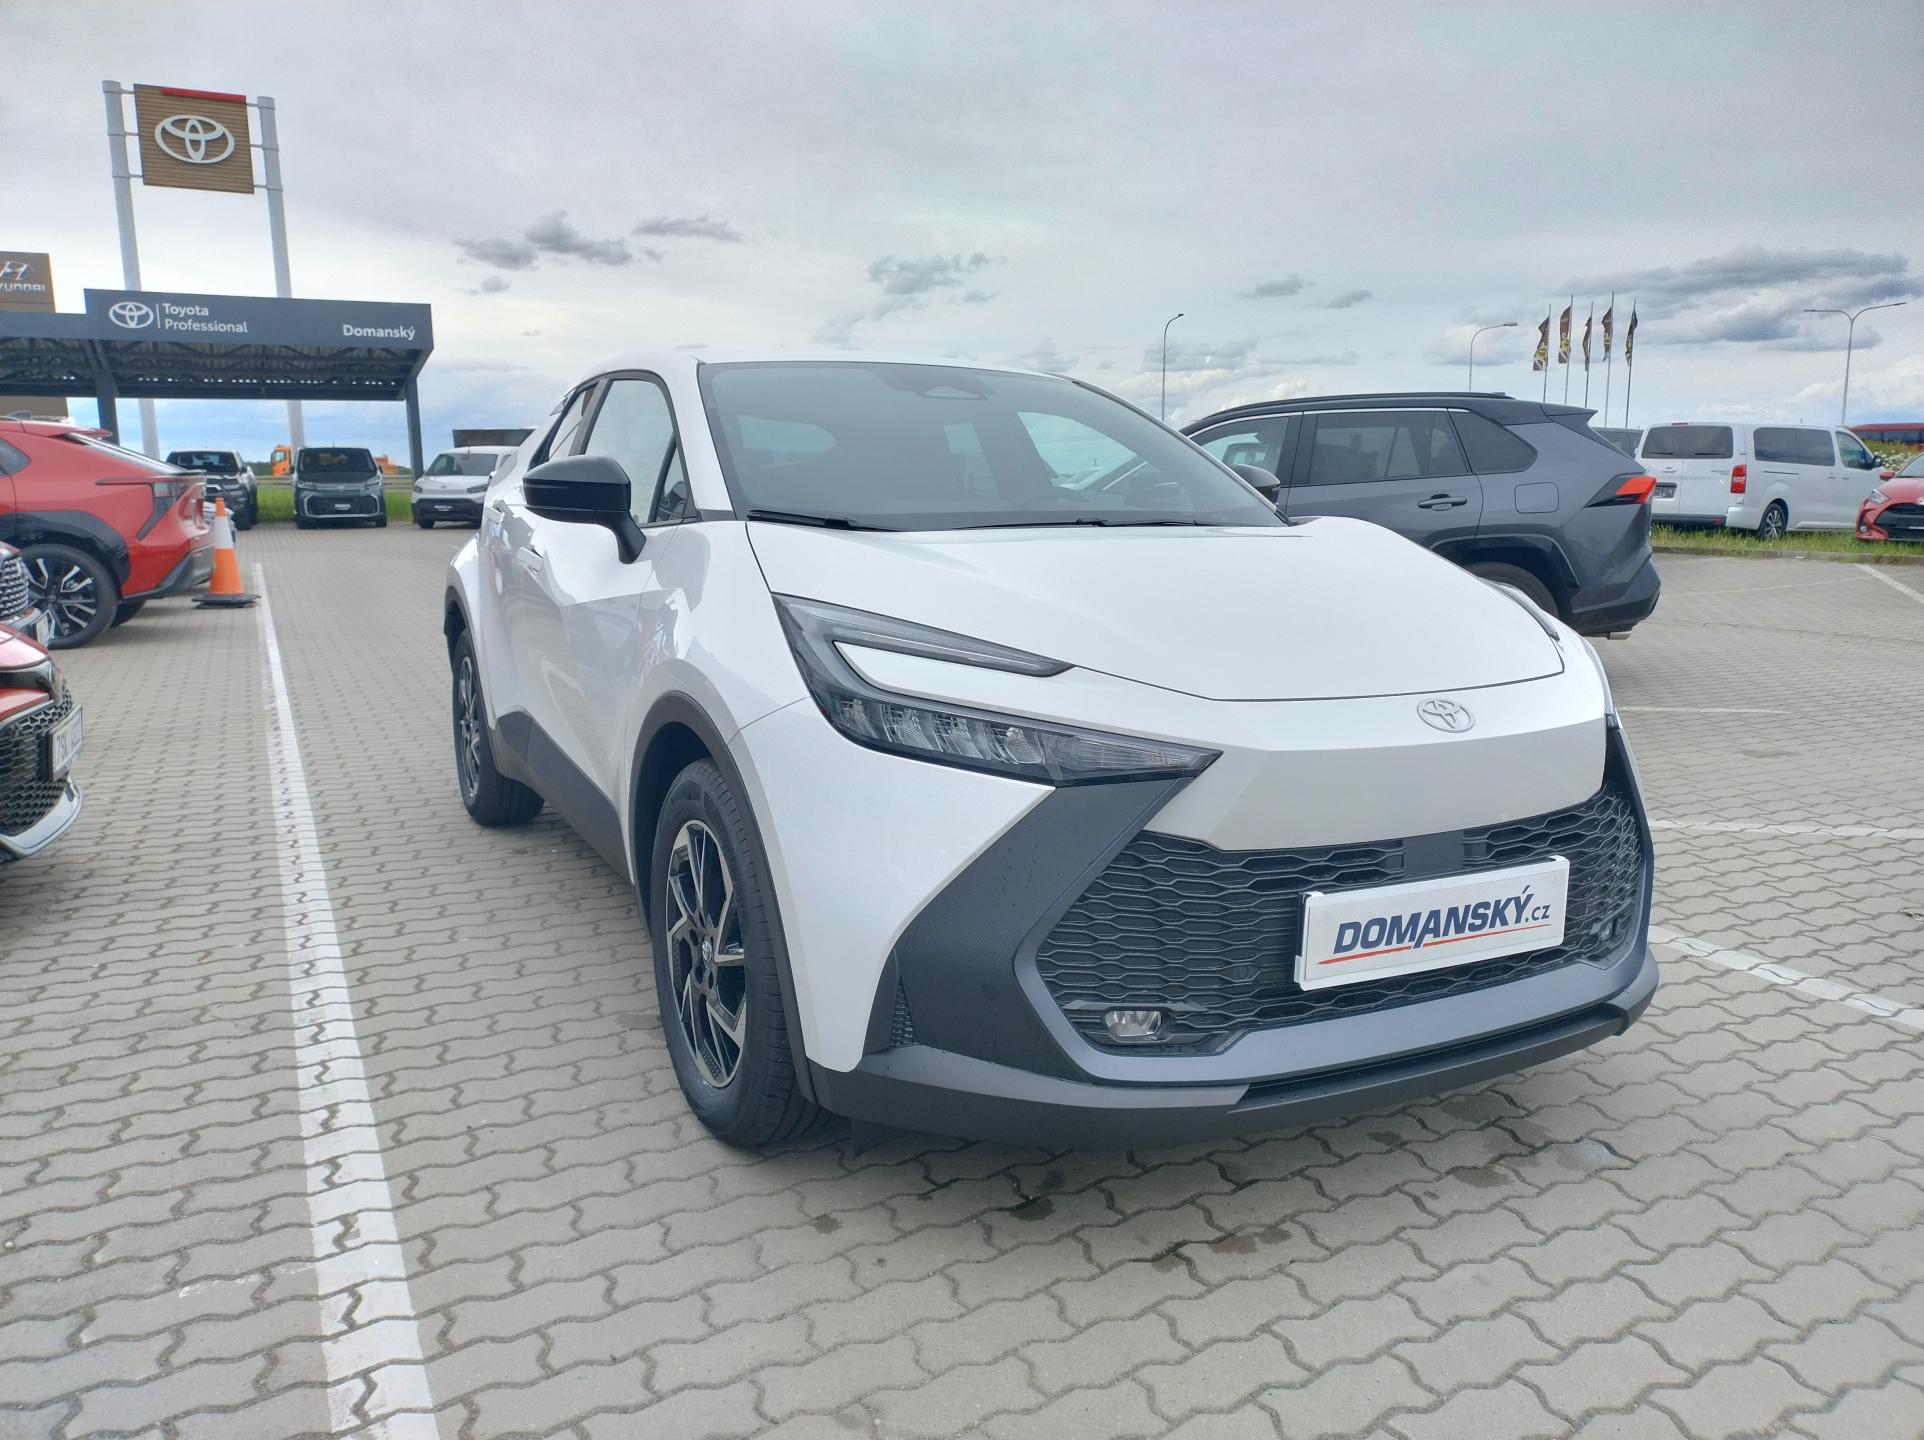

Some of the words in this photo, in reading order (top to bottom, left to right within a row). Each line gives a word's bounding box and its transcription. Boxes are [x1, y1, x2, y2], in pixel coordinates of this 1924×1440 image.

[162, 303, 209, 317] Toyota
[164, 318, 249, 333] Professional
[342, 323, 416, 341] Domanský
